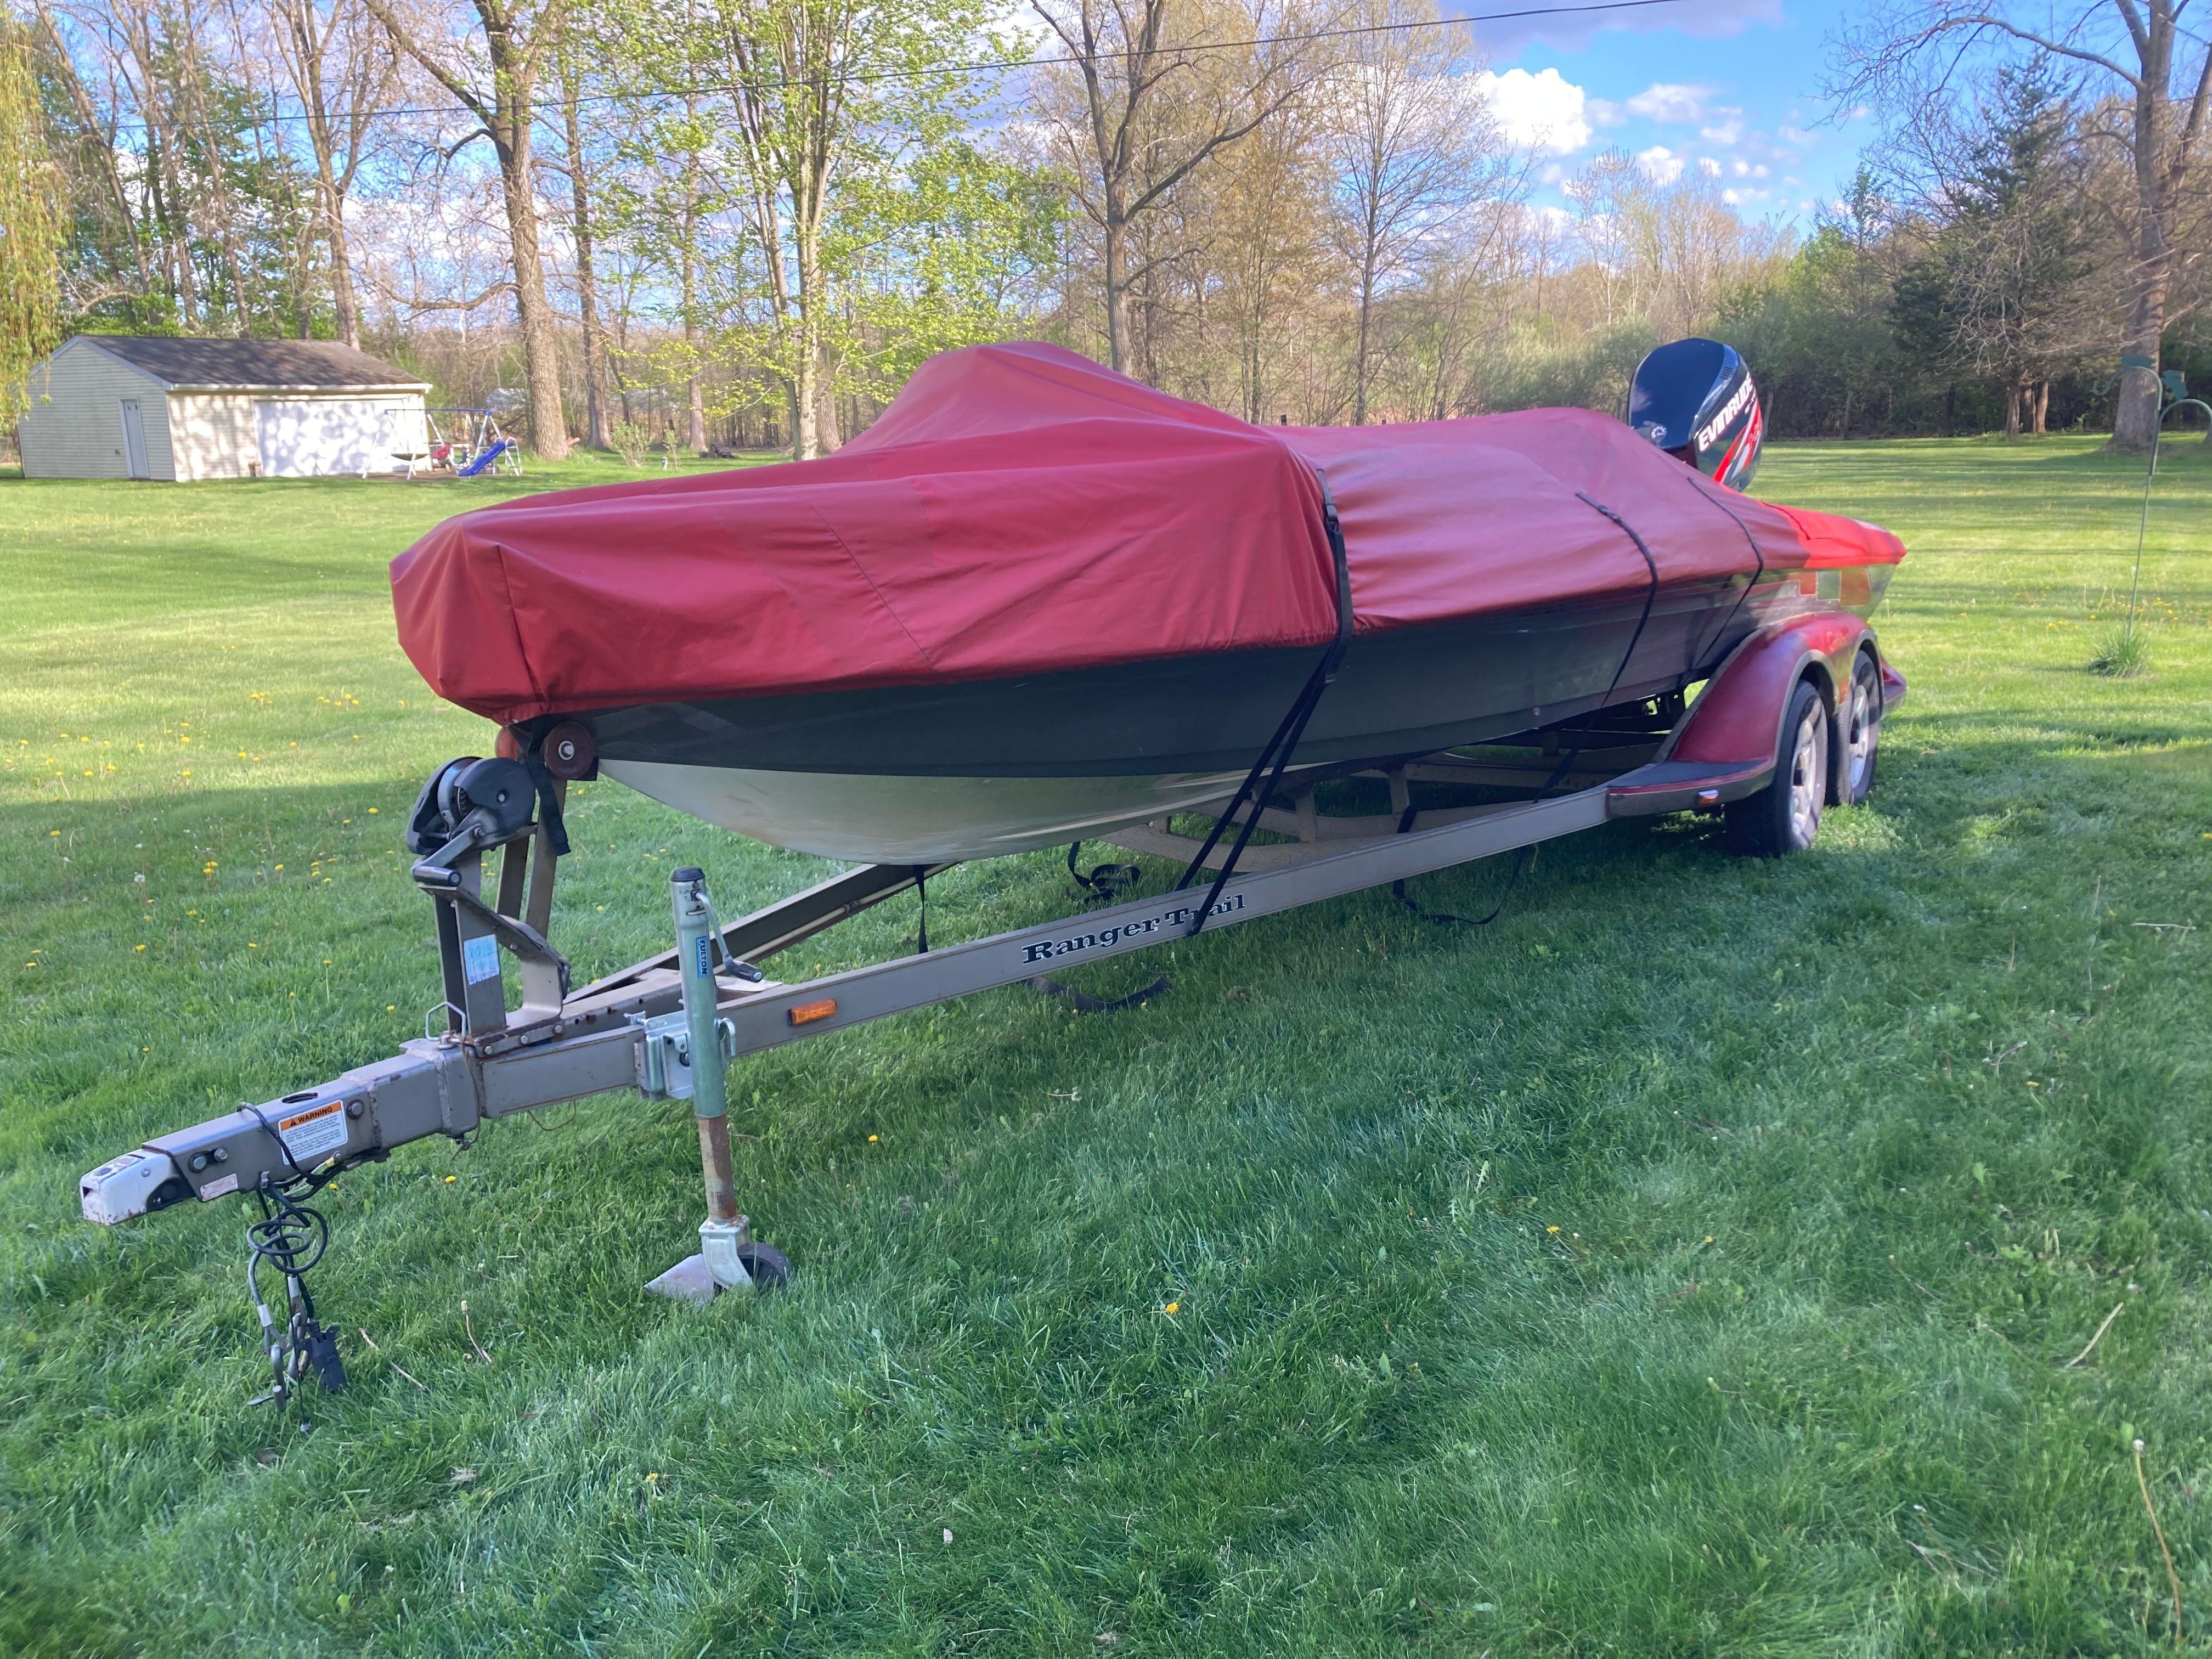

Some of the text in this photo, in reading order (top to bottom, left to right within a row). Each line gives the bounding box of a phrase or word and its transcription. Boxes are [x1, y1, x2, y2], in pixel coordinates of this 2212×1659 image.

[1699, 371, 1753, 452] EVINRUDE
[699, 939, 708, 975] FULTON
[1022, 917, 1161, 964] Ranger
[298, 1106, 332, 1124] WARNING
